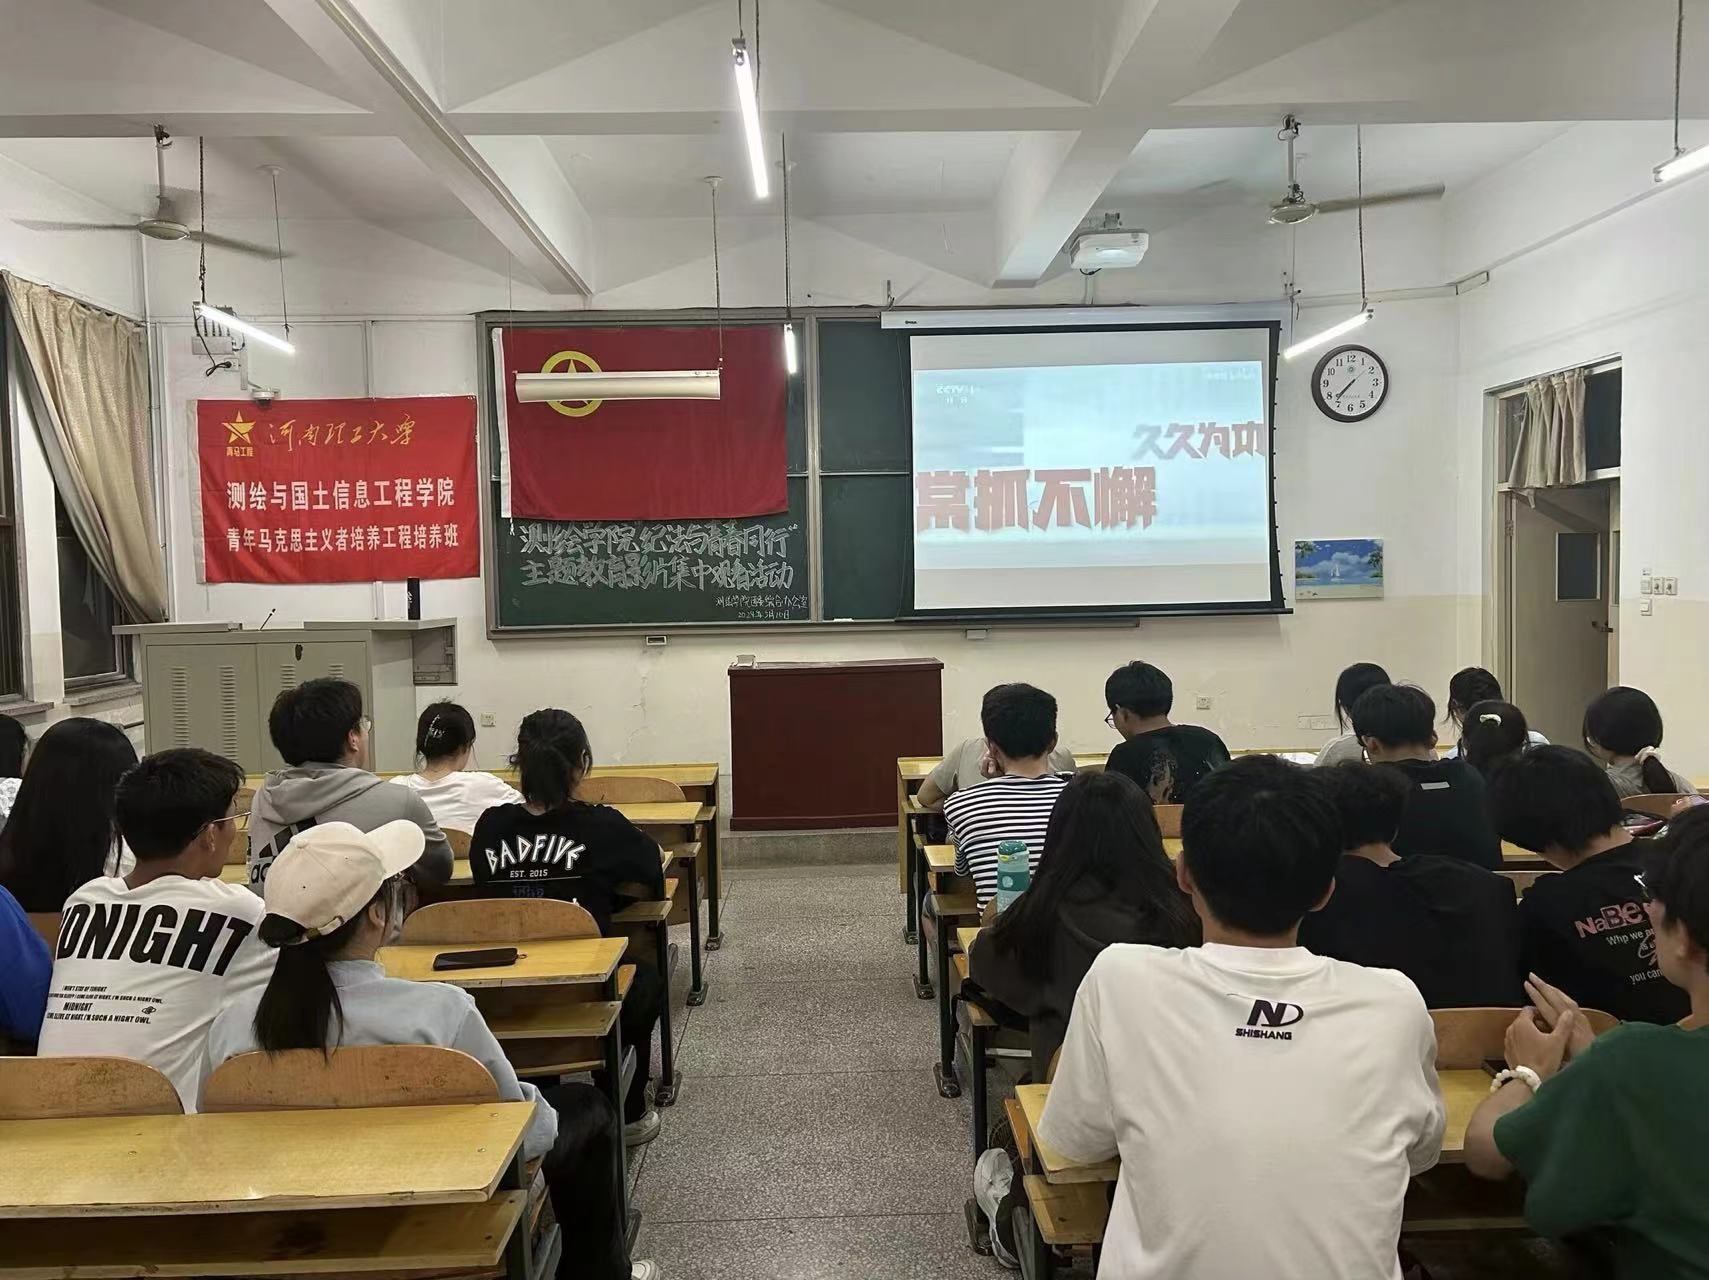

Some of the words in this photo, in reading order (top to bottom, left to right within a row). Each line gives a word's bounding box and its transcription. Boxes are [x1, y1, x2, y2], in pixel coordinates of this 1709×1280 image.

[1347, 354, 1356, 362] 12
[1368, 366, 1374, 374] 2
[1323, 379, 1329, 387] 9
[1372, 378, 1379, 386] 3
[1326, 392, 1332, 400] 8
[1369, 390, 1374, 398] 4
[1347, 404, 1353, 412] 6
[1360, 400, 1365, 408] 5
[226, 446, 254, 457] 青马工程
[227, 477, 455, 511] 测绘与国土信息工程学院
[915, 465, 1157, 532] 常抓不懈
[227, 523, 459, 552] 青年马克思主义者培养工程培养班
[520, 553, 793, 591] 主题教育影片集中观看活动
[510, 870, 526, 878] EST.
[529, 869, 548, 877] 2015
[1630, 930, 1644, 940] we
[1629, 972, 1646, 985] you
[63, 1002, 93, 1011] MIDNIGHT
[91, 1014, 107, 1022] SUCH
[113, 1015, 134, 1023] NIGHT
[1235, 1028, 1292, 1040] SHISHANG
